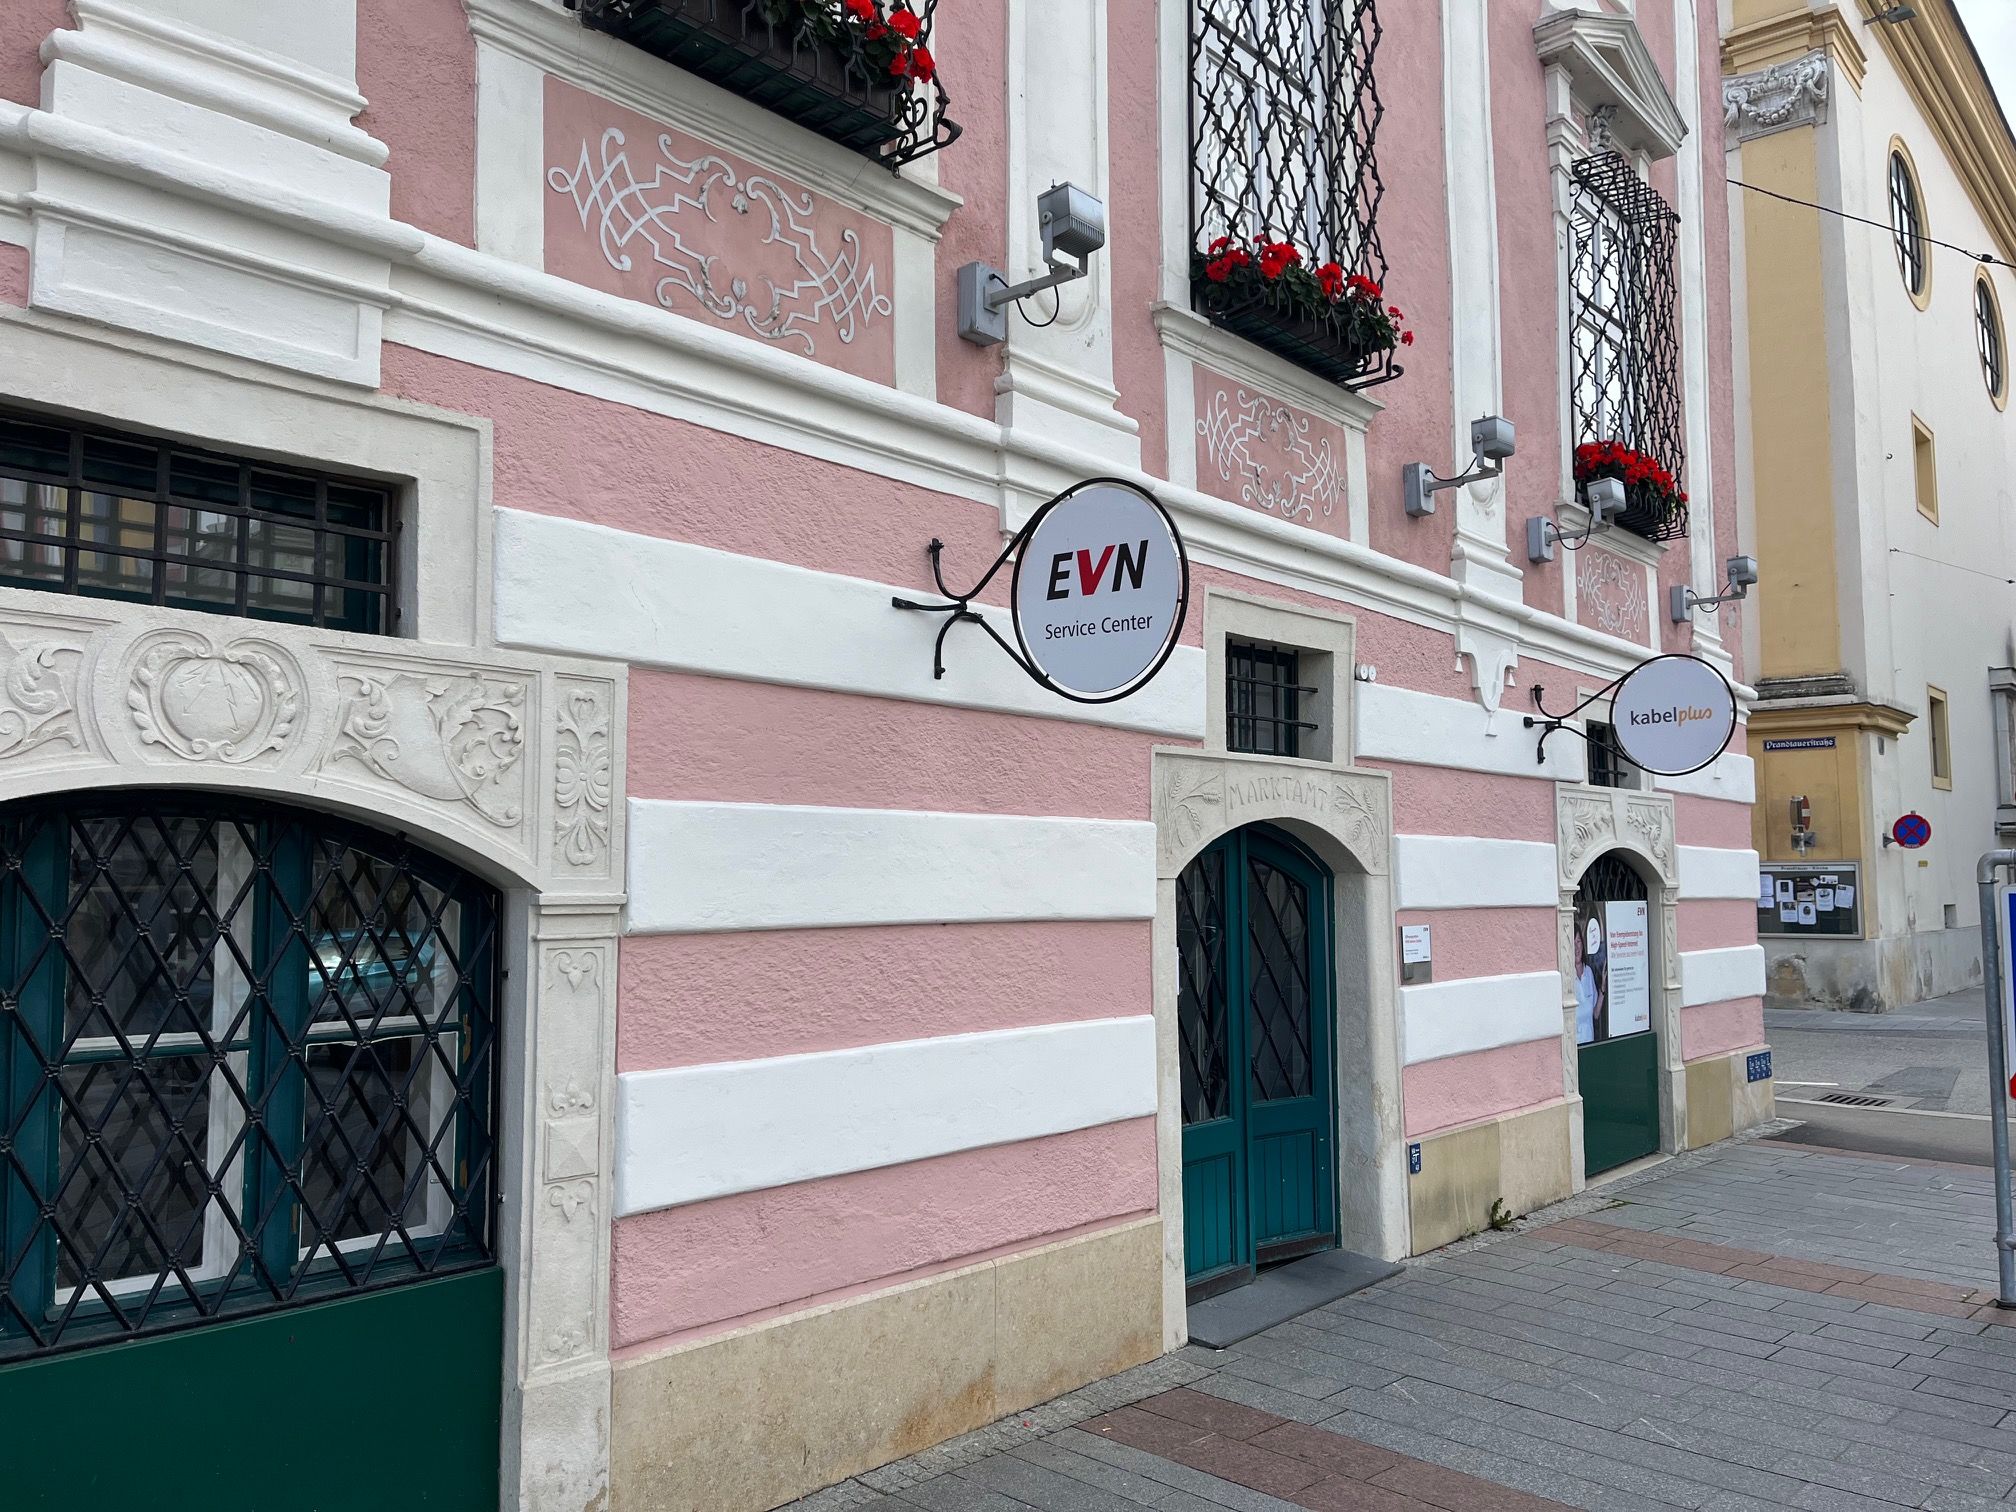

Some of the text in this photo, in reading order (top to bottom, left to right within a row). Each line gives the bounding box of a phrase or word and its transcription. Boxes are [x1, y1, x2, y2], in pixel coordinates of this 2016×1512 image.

[1046, 539, 1149, 601] EVN
[1045, 614, 1153, 639] Service Center
[1630, 705, 1713, 727] kabelplus
[1229, 776, 1328, 811] MARKTAMT
